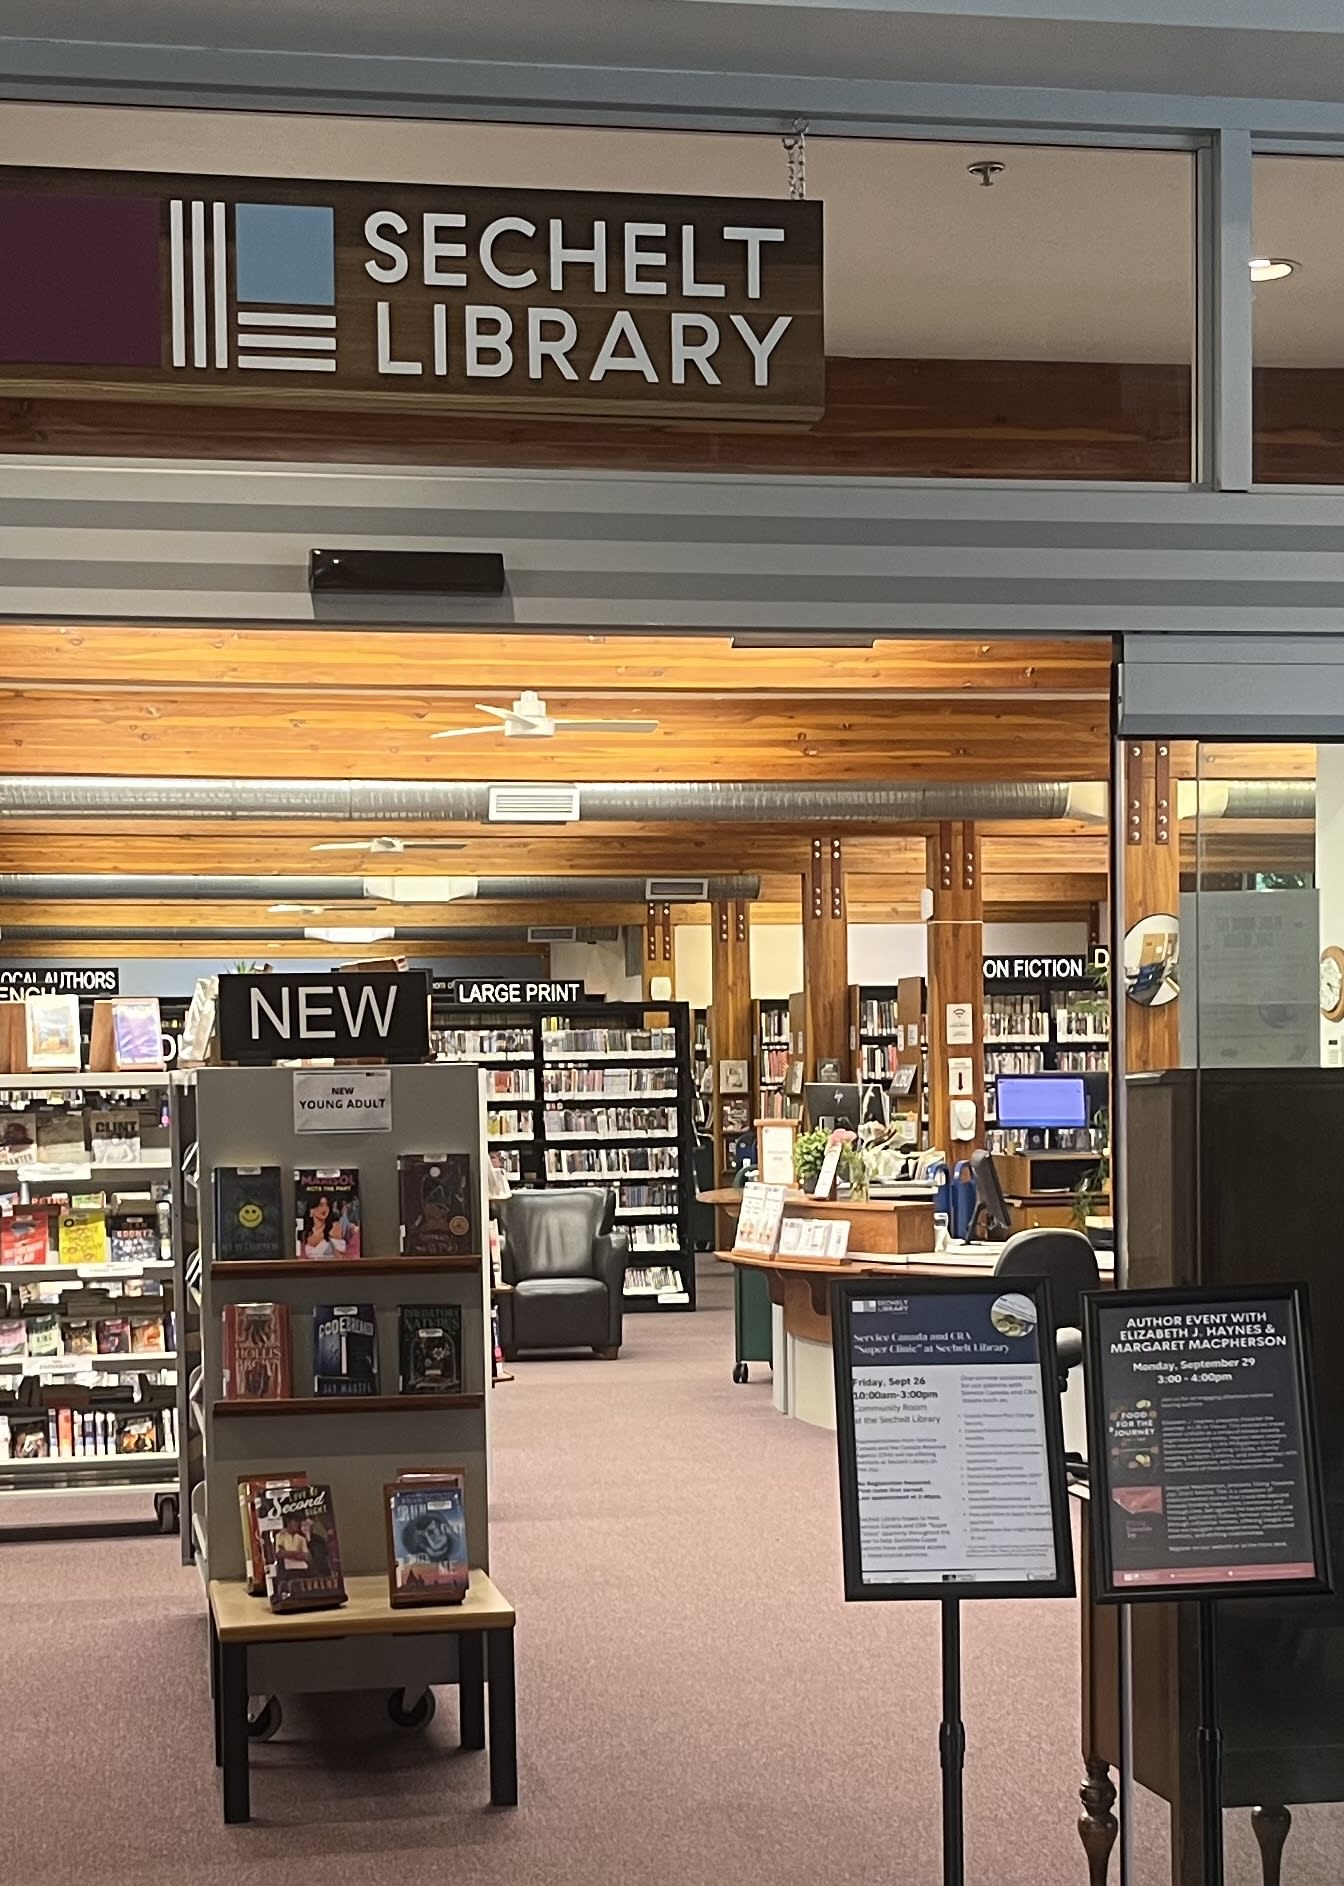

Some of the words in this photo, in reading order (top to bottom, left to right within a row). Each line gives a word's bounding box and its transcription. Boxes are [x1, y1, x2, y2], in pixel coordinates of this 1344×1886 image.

[364, 209, 786, 300] SECHELT
[376, 300, 794, 387] LIBRARY
[1014, 958, 1083, 978] FICTION
[45, 971, 116, 990] AUTHORS
[459, 983, 521, 1003] LARGE
[526, 983, 579, 1002] PRINT
[250, 985, 398, 1040] NEW
[331, 1087, 355, 1096] NEW
[299, 1099, 344, 1110] YOUNG
[346, 1098, 386, 1109] ADULT
[95, 1121, 137, 1134] CLINT
[1126, 1316, 1182, 1328] AUTHOR
[1186, 1314, 1228, 1325] EVENT
[1231, 1312, 1267, 1323] WITH
[854, 1333, 888, 1342] Service
[892, 1332, 928, 1341] Canada
[930, 1332, 948, 1341] and
[1120, 1327, 1189, 1341] ELIZABETH
[1192, 1327, 1203, 1337] J.
[1206, 1325, 1262, 1337] HAYNES
[1265, 1324, 1275, 1334] &
[935, 1344, 971, 1353] Sechelt
[973, 1344, 1008, 1354] Library
[1110, 1340, 1185, 1353] MARGARET
[1189, 1336, 1287, 1350] MACPHERSON
[236, 1348, 281, 1359] HOLLIS
[1133, 1361, 1178, 1372] Monday,
[1181, 1358, 1240, 1371] September
[1242, 1357, 1256, 1367] 29
[853, 1378, 885, 1388] Friday,
[889, 1377, 911, 1387] Sept
[913, 1377, 926, 1385] 26
[1157, 1374, 1182, 1384] 3:00
[1191, 1372, 1233, 1382] 4:00pm
[854, 1390, 938, 1400] 10:00am-3:00pm
[855, 1404, 901, 1413] Community
[903, 1403, 927, 1411] Room
[863, 1416, 877, 1424] the
[912, 1415, 940, 1424] Library
[1121, 1411, 1147, 1419] FOOD
[1116, 1419, 1134, 1428] FOR
[1136, 1419, 1153, 1428] THE
[1114, 1428, 1155, 1437] JOURNEY
[268, 1491, 325, 1518] Second
